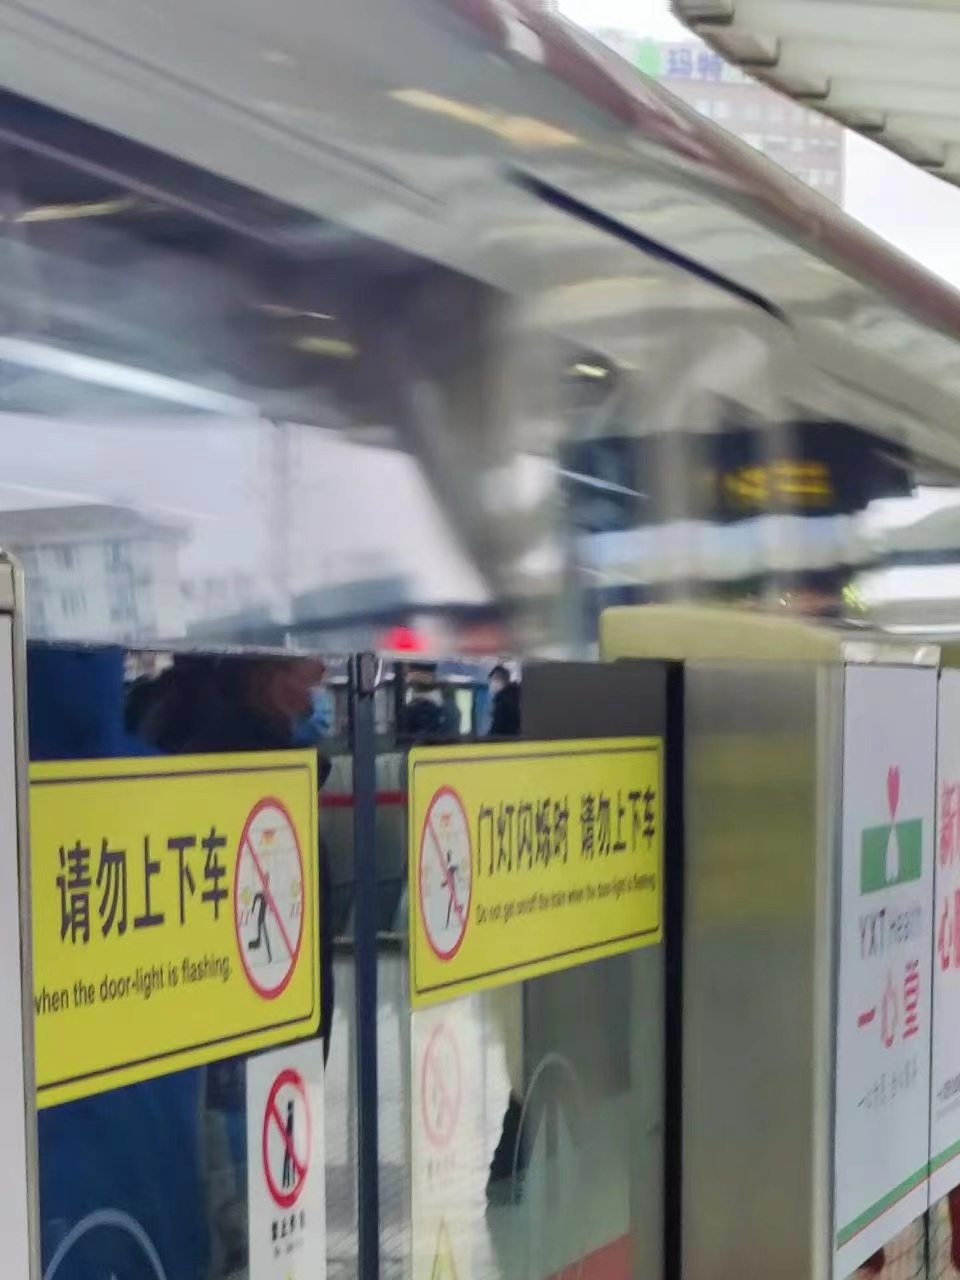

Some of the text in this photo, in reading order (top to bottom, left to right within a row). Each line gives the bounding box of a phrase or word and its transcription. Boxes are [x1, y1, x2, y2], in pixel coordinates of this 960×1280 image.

[580, 784, 656, 861] 请勿上下车
[56, 827, 228, 946] 请勿上下车
[73, 979, 95, 1007] the
[100, 964, 164, 1000] door-light
[168, 961, 178, 987] is
